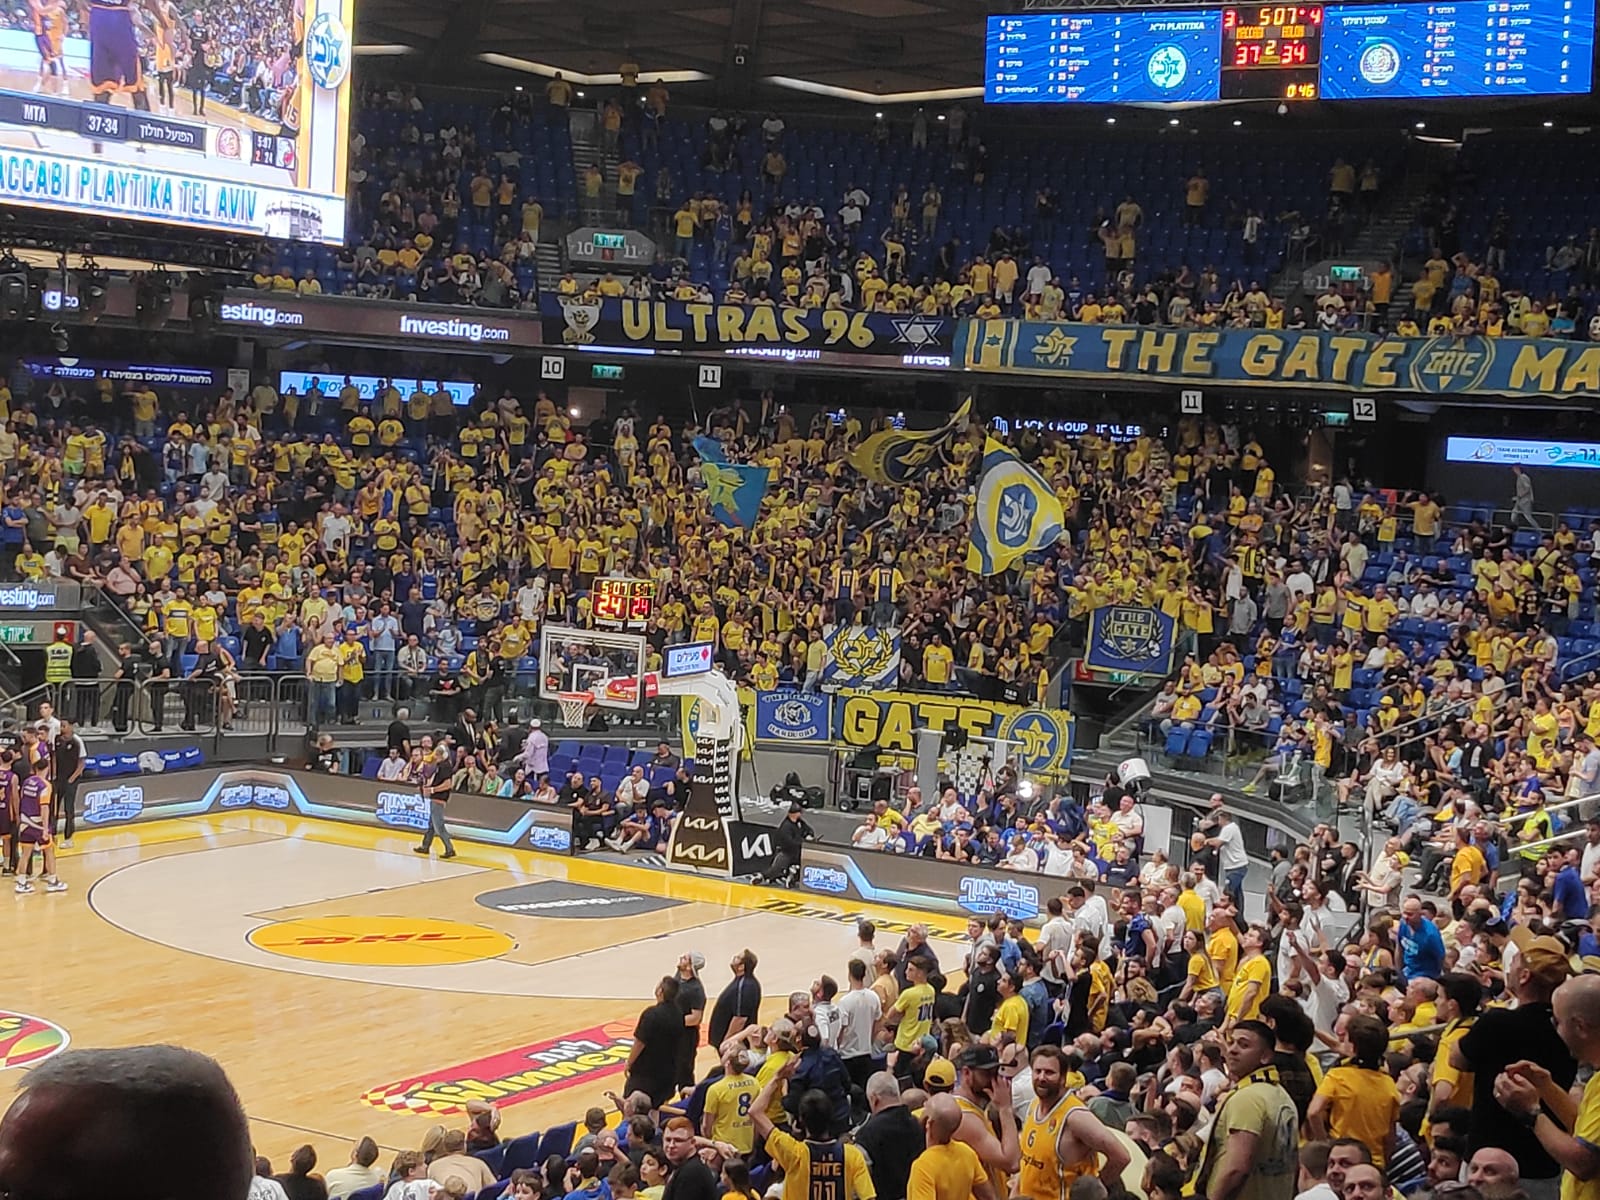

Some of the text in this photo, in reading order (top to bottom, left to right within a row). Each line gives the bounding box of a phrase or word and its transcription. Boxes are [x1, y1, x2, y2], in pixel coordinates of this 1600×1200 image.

[23, 104, 47, 123] MTA
[79, 166, 173, 212] PLAYTIKA
[181, 180, 211, 216] TEL
[218, 186, 257, 222] AVIV
[400, 315, 509, 341] Investing.com
[622, 298, 875, 348] ULTRAS 96
[1102, 328, 1220, 375] THE
[1241, 334, 1406, 387] GATE
[543, 360, 562, 375] 10
[703, 369, 718, 383] 11
[1184, 394, 1198, 409] 11
[1356, 402, 1373, 417] 12
[601, 581, 628, 595] 5:07
[598, 594, 622, 615] 24
[632, 597, 648, 616] 24
[1119, 611, 1146, 623] THE
[1113, 625, 1149, 637] GATE
[684, 815, 719, 832] KIA
[674, 842, 725, 864] KIA
[738, 1093, 752, 1117] 8
[1028, 1130, 1037, 1148] 6
